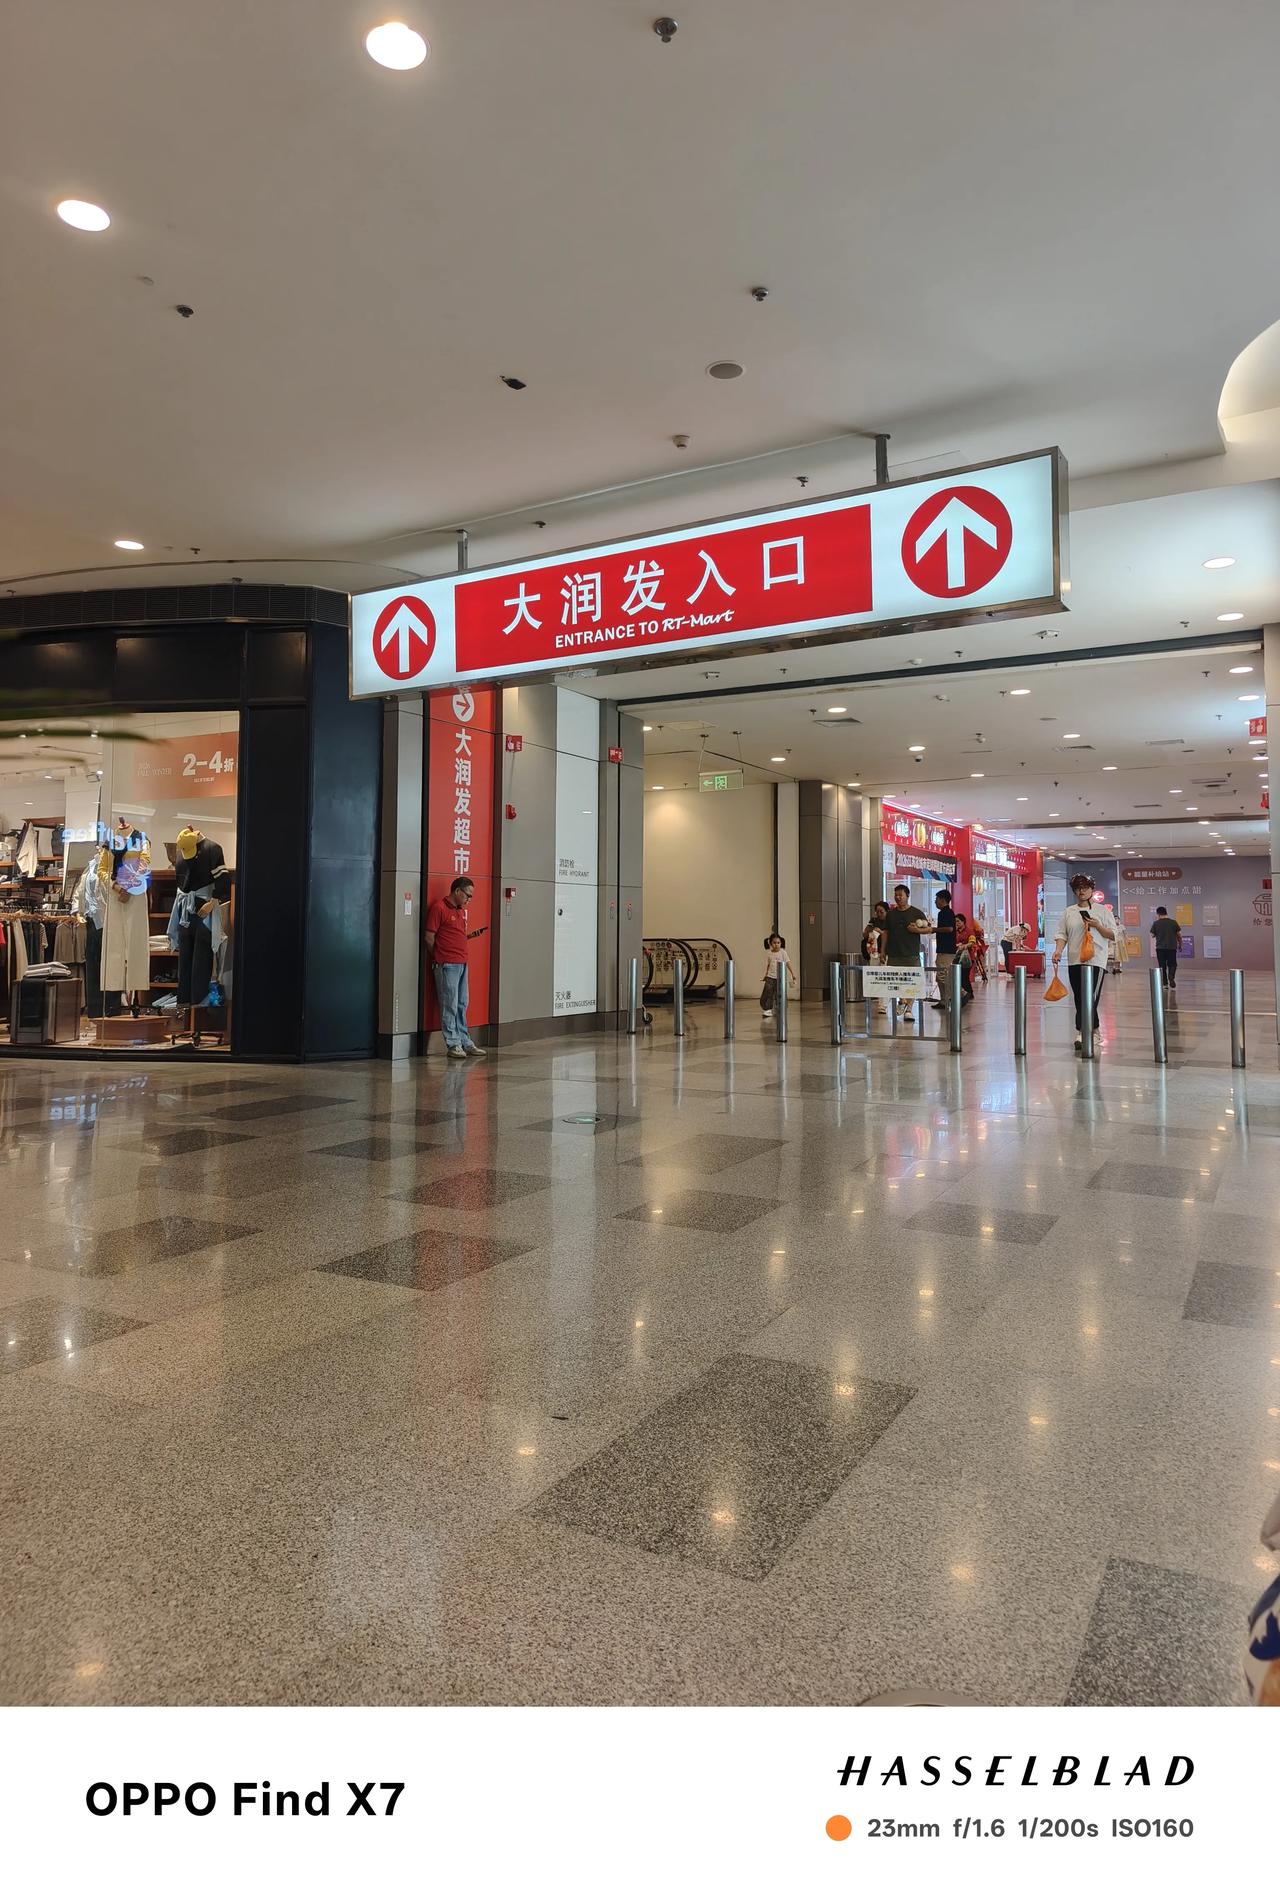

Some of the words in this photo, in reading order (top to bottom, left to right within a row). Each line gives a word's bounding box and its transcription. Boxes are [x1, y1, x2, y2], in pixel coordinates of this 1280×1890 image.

[503, 535, 805, 635] 大润发入口
[555, 627, 636, 649] ENTRANCE
[638, 620, 660, 636] TO
[661, 609, 735, 633] RT-Mart
